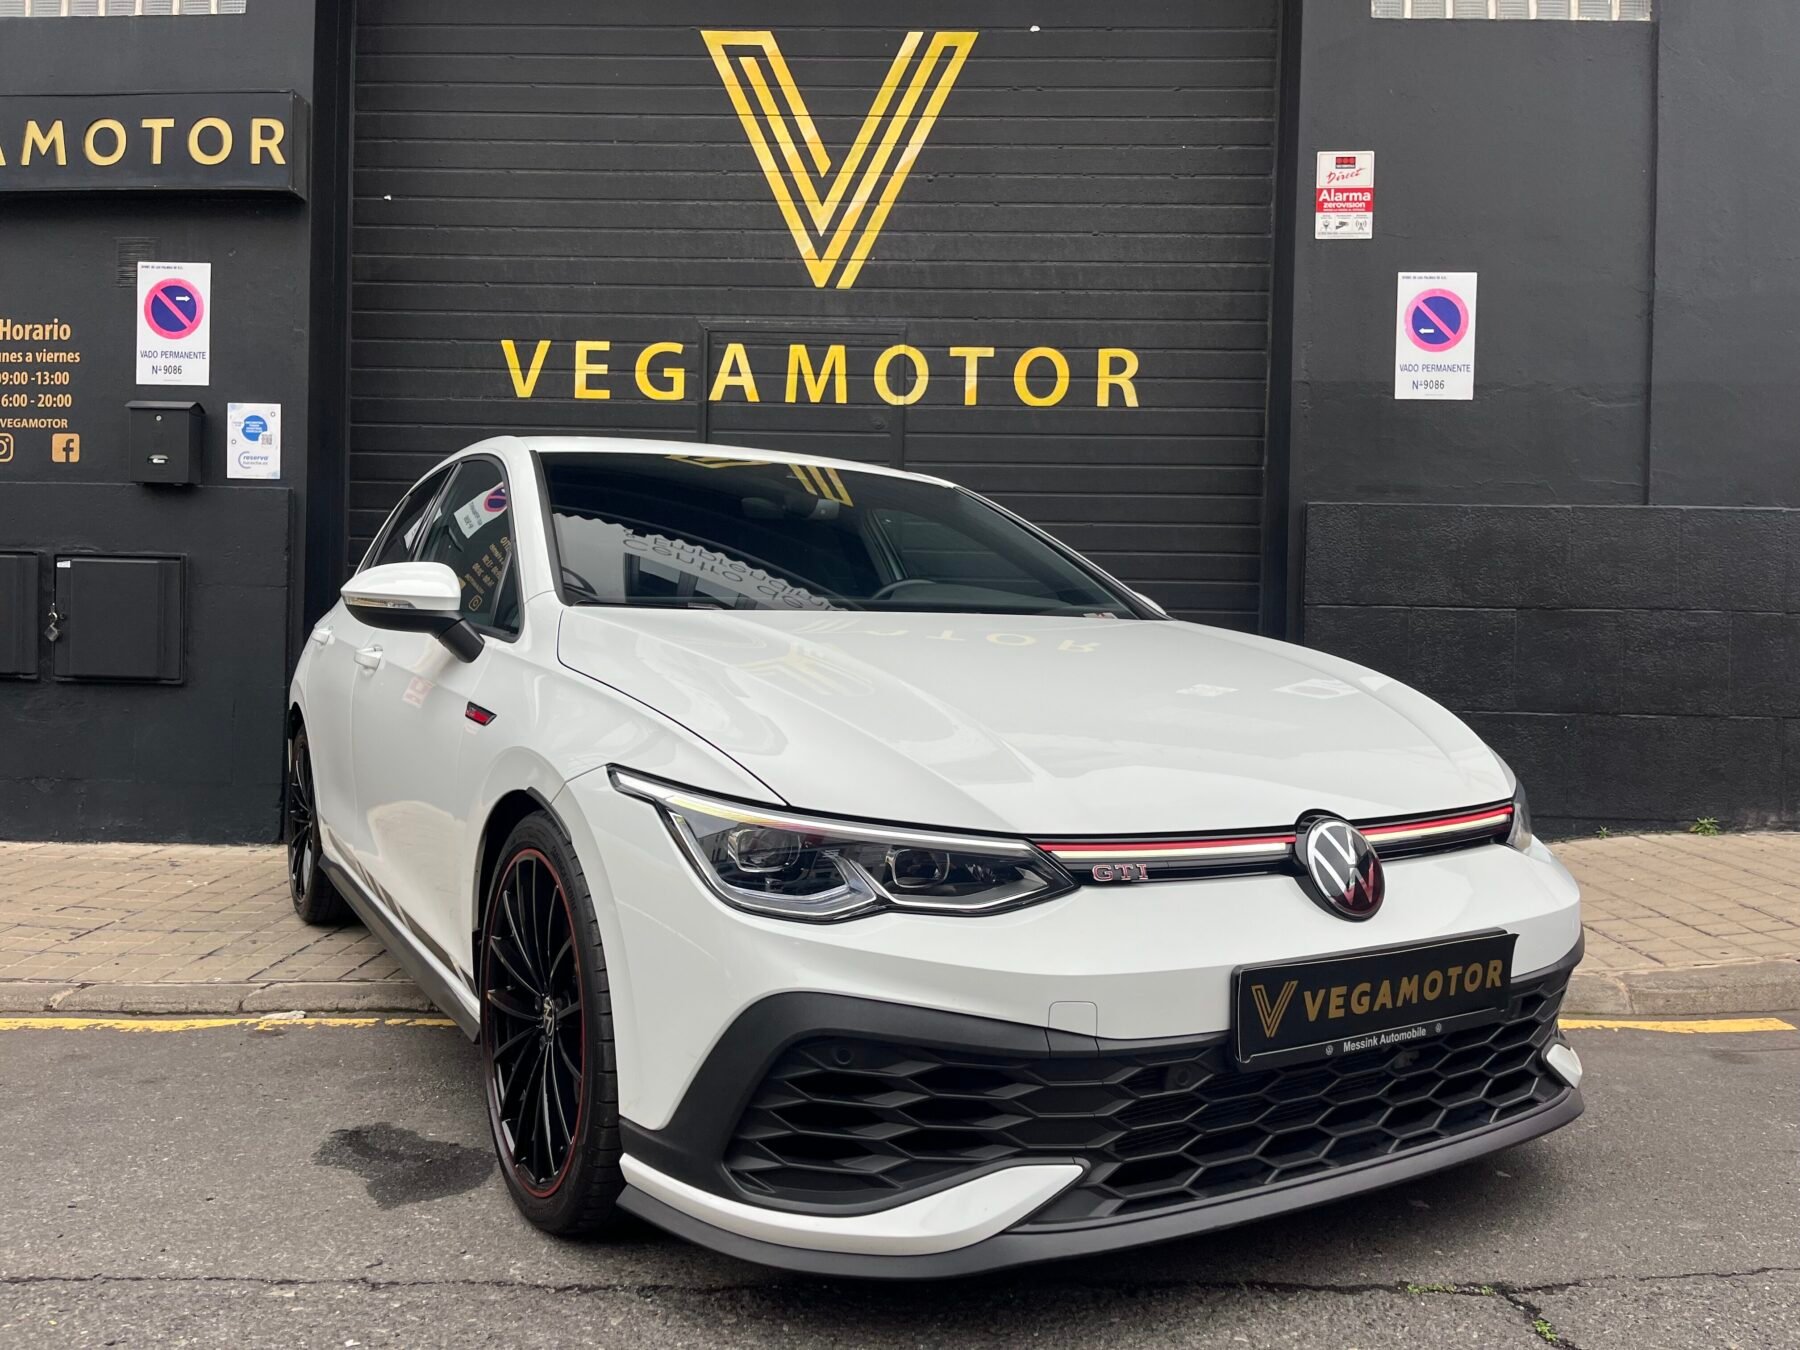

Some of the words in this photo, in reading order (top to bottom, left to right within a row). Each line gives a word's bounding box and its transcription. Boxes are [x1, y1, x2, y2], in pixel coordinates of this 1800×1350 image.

[0, 117, 286, 166] MOTOR
[1319, 188, 1371, 202] Alarma
[1323, 201, 1366, 209] zerovision
[0, 318, 71, 341] Horario
[25, 351, 33, 363] a
[36, 349, 81, 363] viernes
[140, 350, 158, 359] VADO
[160, 350, 207, 360] PERMANENTE
[501, 340, 1140, 408] VEGAMOTOR
[1399, 364, 1419, 372] VADO
[1421, 364, 1471, 373] PERMANENTE
[0, 371, 28, 385] 9:00
[37, 394, 72, 408] 20:00
[0, 418, 68, 429] VEGAMOTOR
[1092, 863, 1148, 882] GTI
[1304, 959, 1504, 1022] VEGAMOTOR
[1343, 1036, 1378, 1053] Messink
[1380, 1027, 1427, 1045] Automobile
